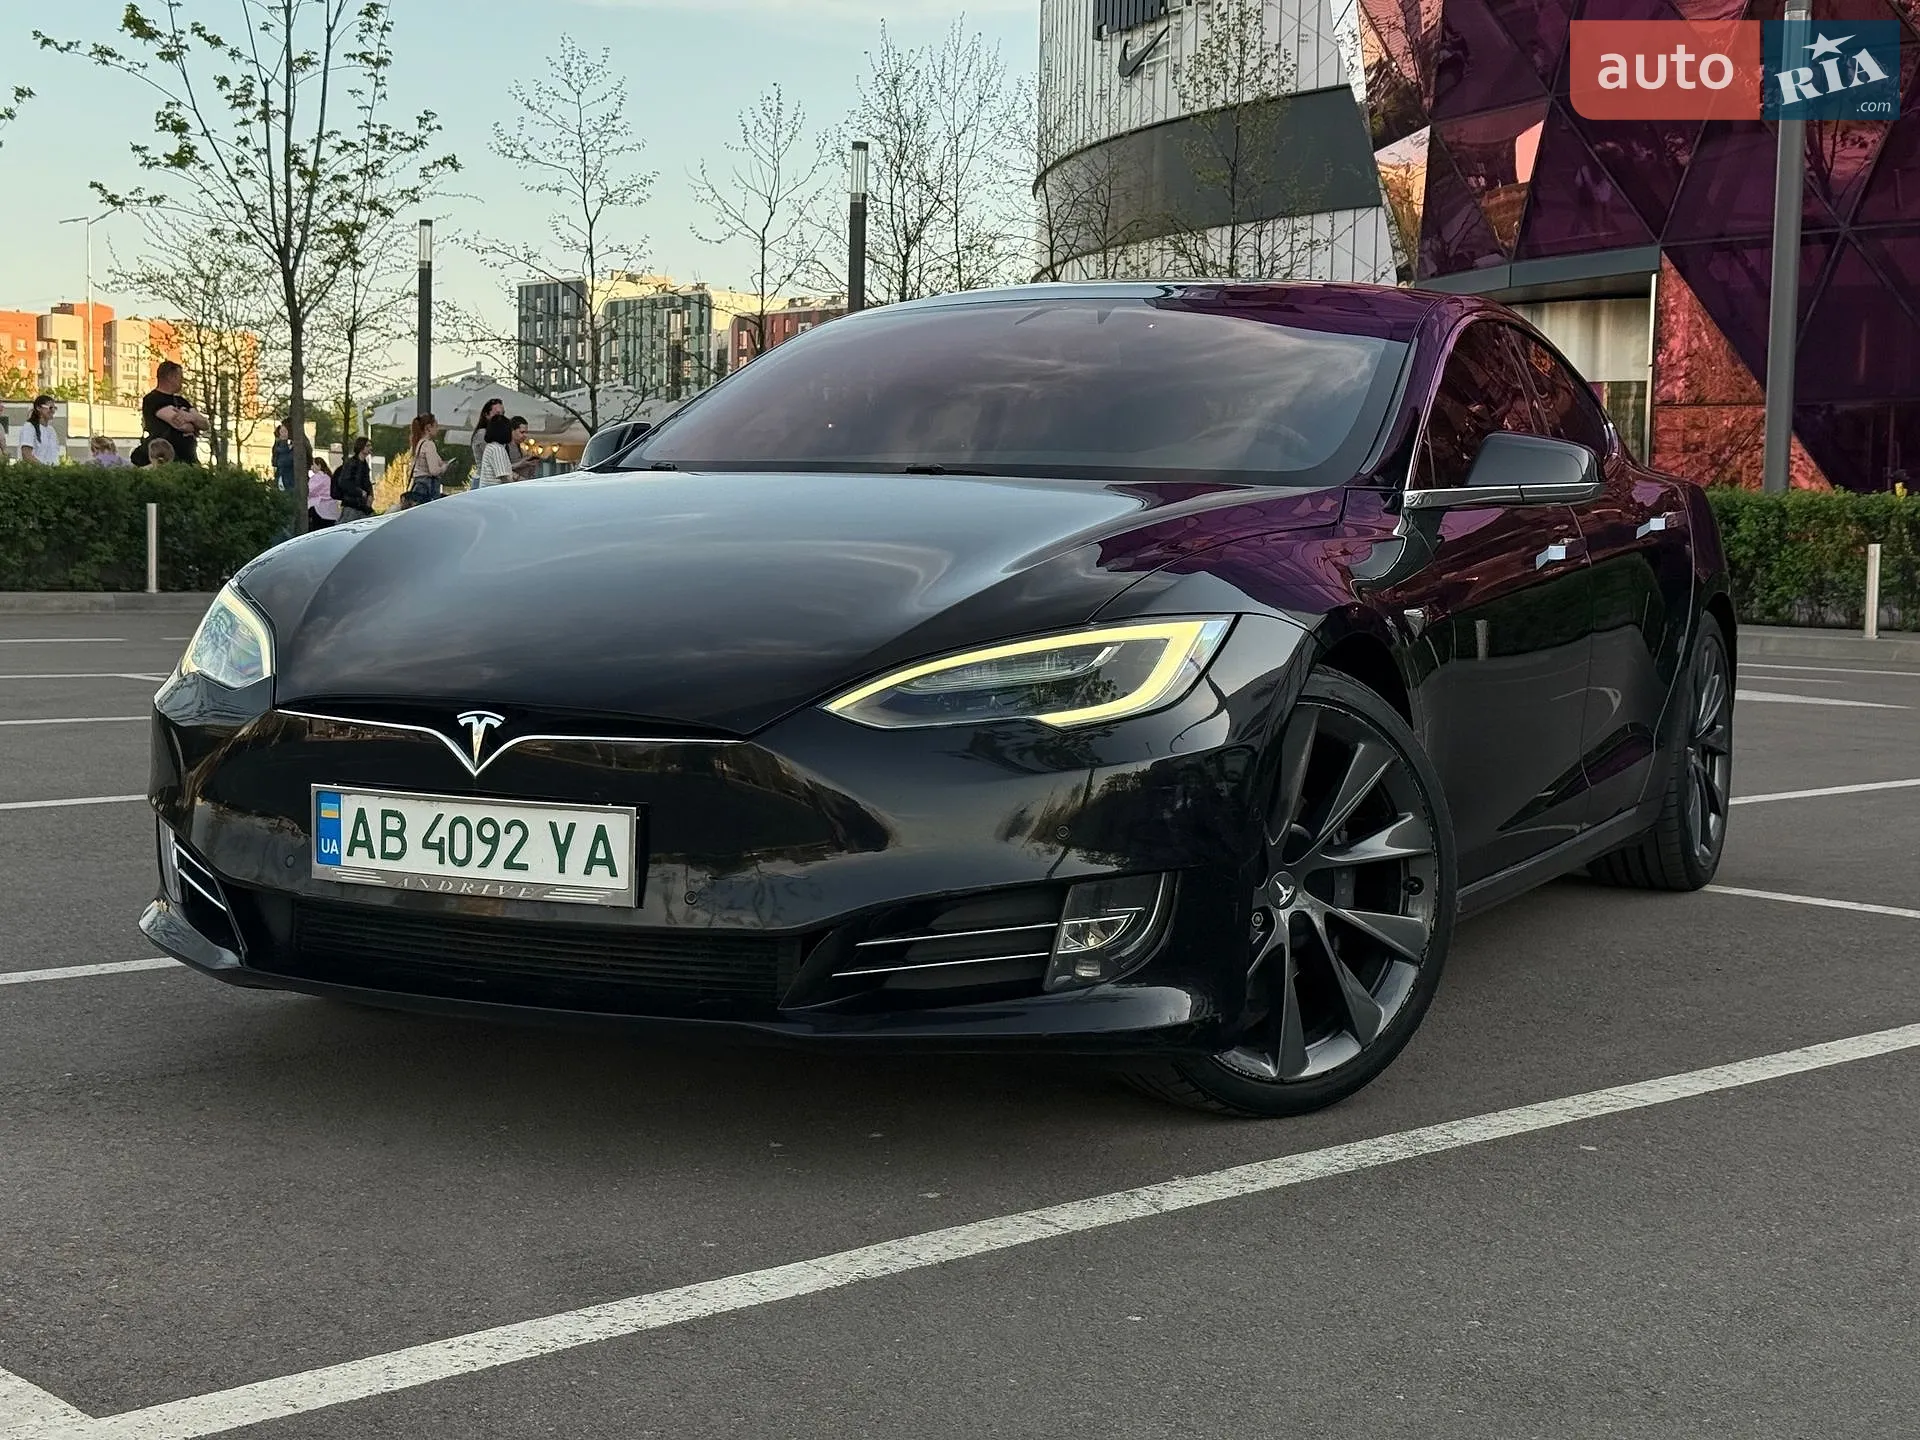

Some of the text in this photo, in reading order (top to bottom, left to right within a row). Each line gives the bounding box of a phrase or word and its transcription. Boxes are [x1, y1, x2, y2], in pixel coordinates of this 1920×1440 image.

[321, 838, 339, 855] UA
[347, 807, 619, 878] AB 4092 YA
